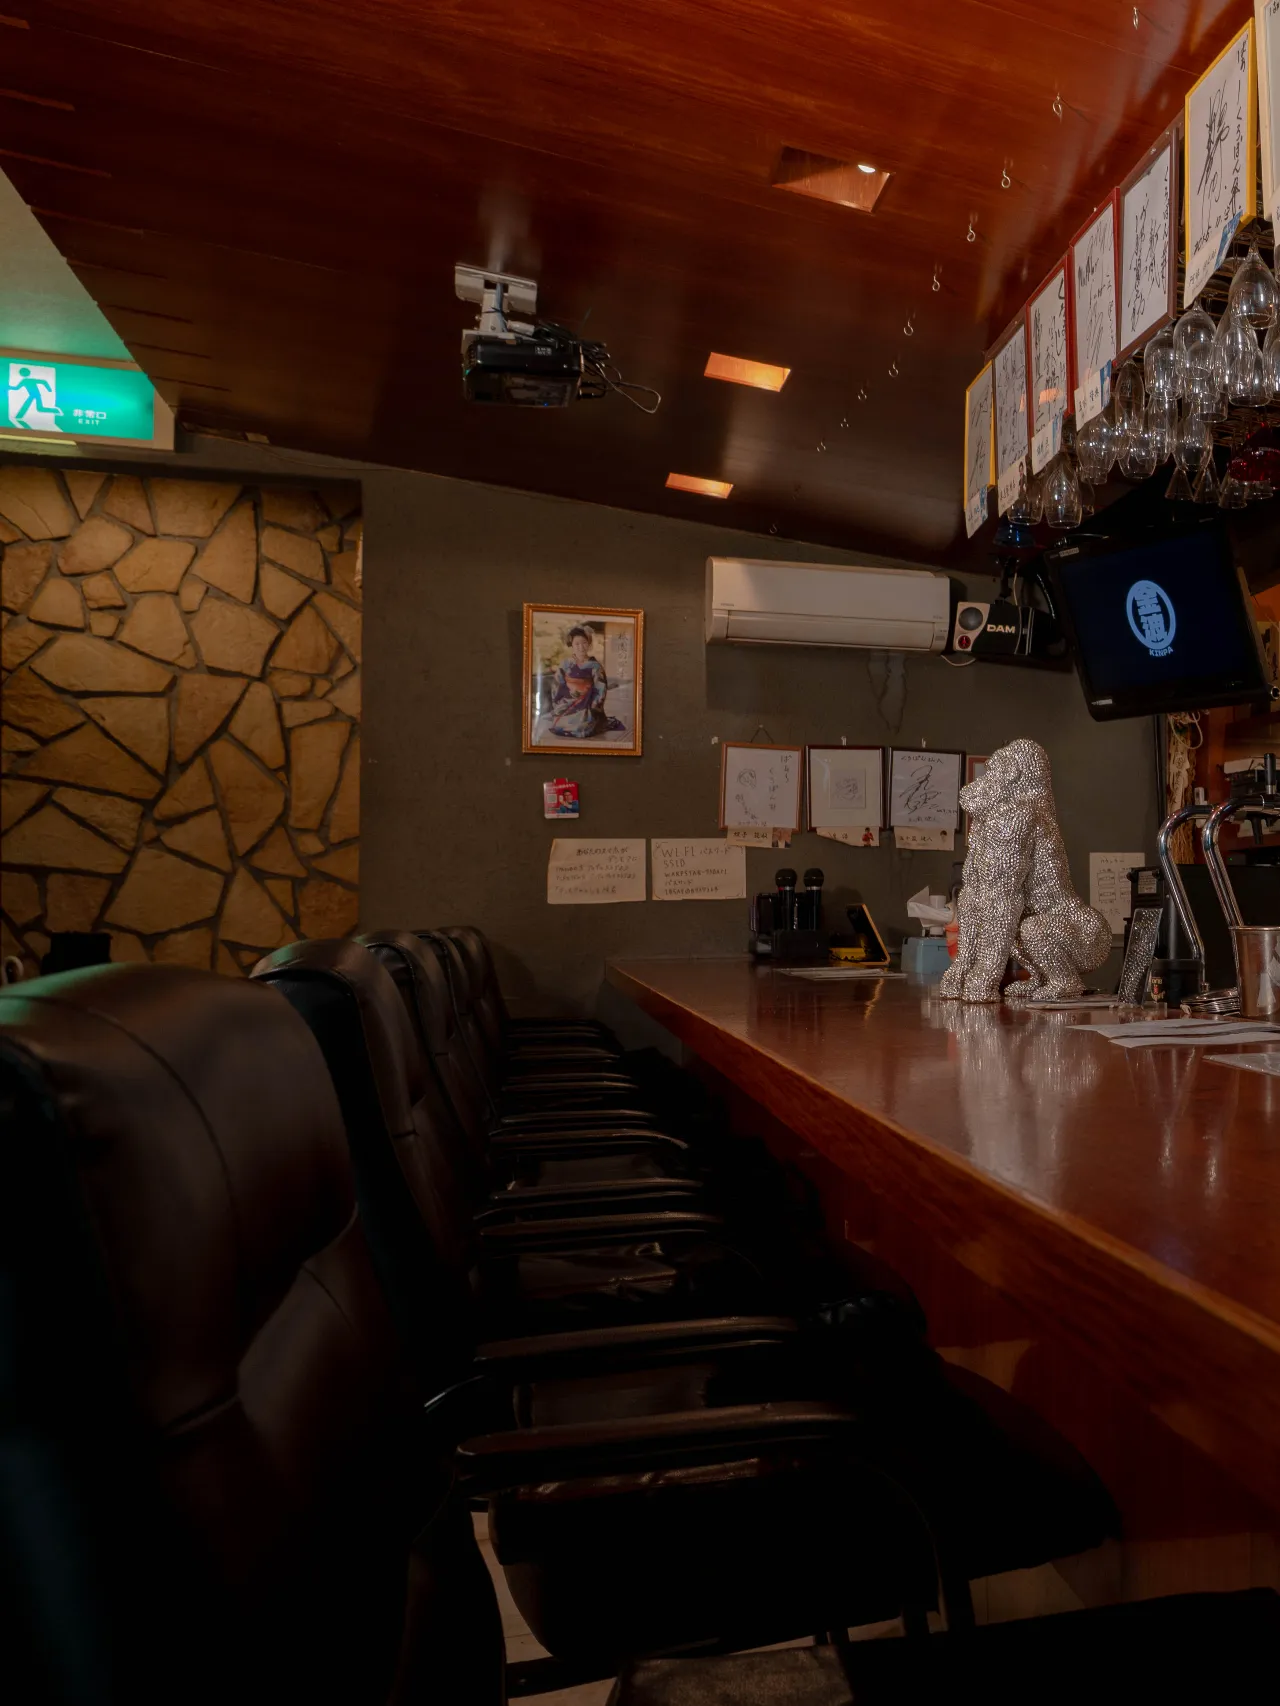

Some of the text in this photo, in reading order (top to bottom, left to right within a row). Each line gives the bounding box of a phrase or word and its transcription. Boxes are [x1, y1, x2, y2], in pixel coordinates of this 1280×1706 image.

[72, 408, 107, 420] 非常口
[986, 624, 1016, 634] DAM
[1148, 645, 1175, 657] KINPA
